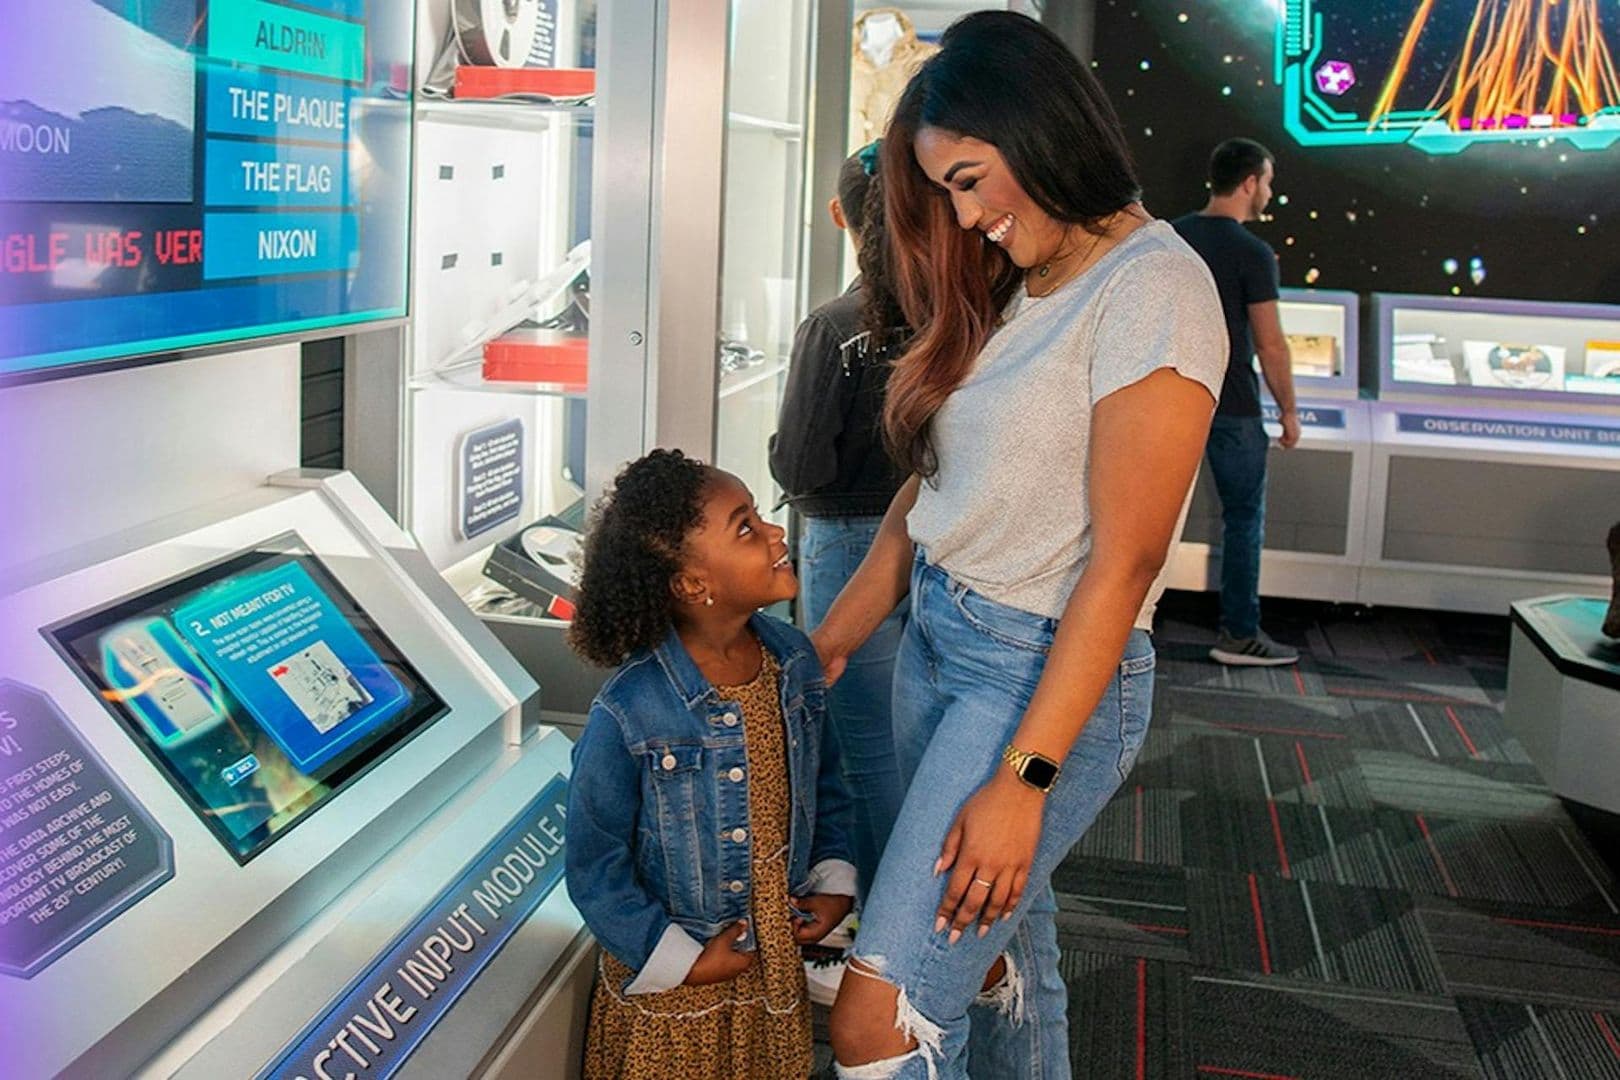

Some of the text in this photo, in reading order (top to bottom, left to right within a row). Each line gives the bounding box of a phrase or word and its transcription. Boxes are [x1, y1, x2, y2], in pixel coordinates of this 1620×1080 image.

[255, 20, 326, 59] ALDRIN
[229, 87, 345, 129] THE PLAQUE
[242, 161, 331, 193] THE FLAG
[0, 230, 202, 273] GLE WAS VER
[258, 229, 316, 260] NIXON
[1424, 418, 1546, 437] OBSERVATION
[1551, 427, 1591, 441] UNIT
[210, 611, 233, 629] NOT
[230, 596, 266, 619] MEANT
[262, 588, 284, 605] FOR
[280, 583, 295, 597] TV
[6, 766, 38, 789] FIRST
[36, 750, 70, 773] STEPS
[10, 786, 36, 804] THE
[32, 767, 71, 793] HOMES
[69, 759, 84, 774] OF
[2, 781, 81, 828] WAS NOT EASY.
[19, 828, 48, 851] DATA
[46, 802, 93, 835] ARCHIVE
[89, 790, 113, 810] AND
[0, 813, 105, 884] COVER SOME OF THE
[43, 845, 84, 875] BEHIND
[81, 832, 105, 850] THE
[102, 815, 132, 838] MOST
[49, 875, 66, 890] TV
[65, 839, 125, 881] BROADCAST
[122, 829, 137, 844] OF
[28, 903, 55, 924] THE
[74, 857, 127, 895] CENTURY!
[294, 816, 566, 1080] CTIVE INPUT MODULE
